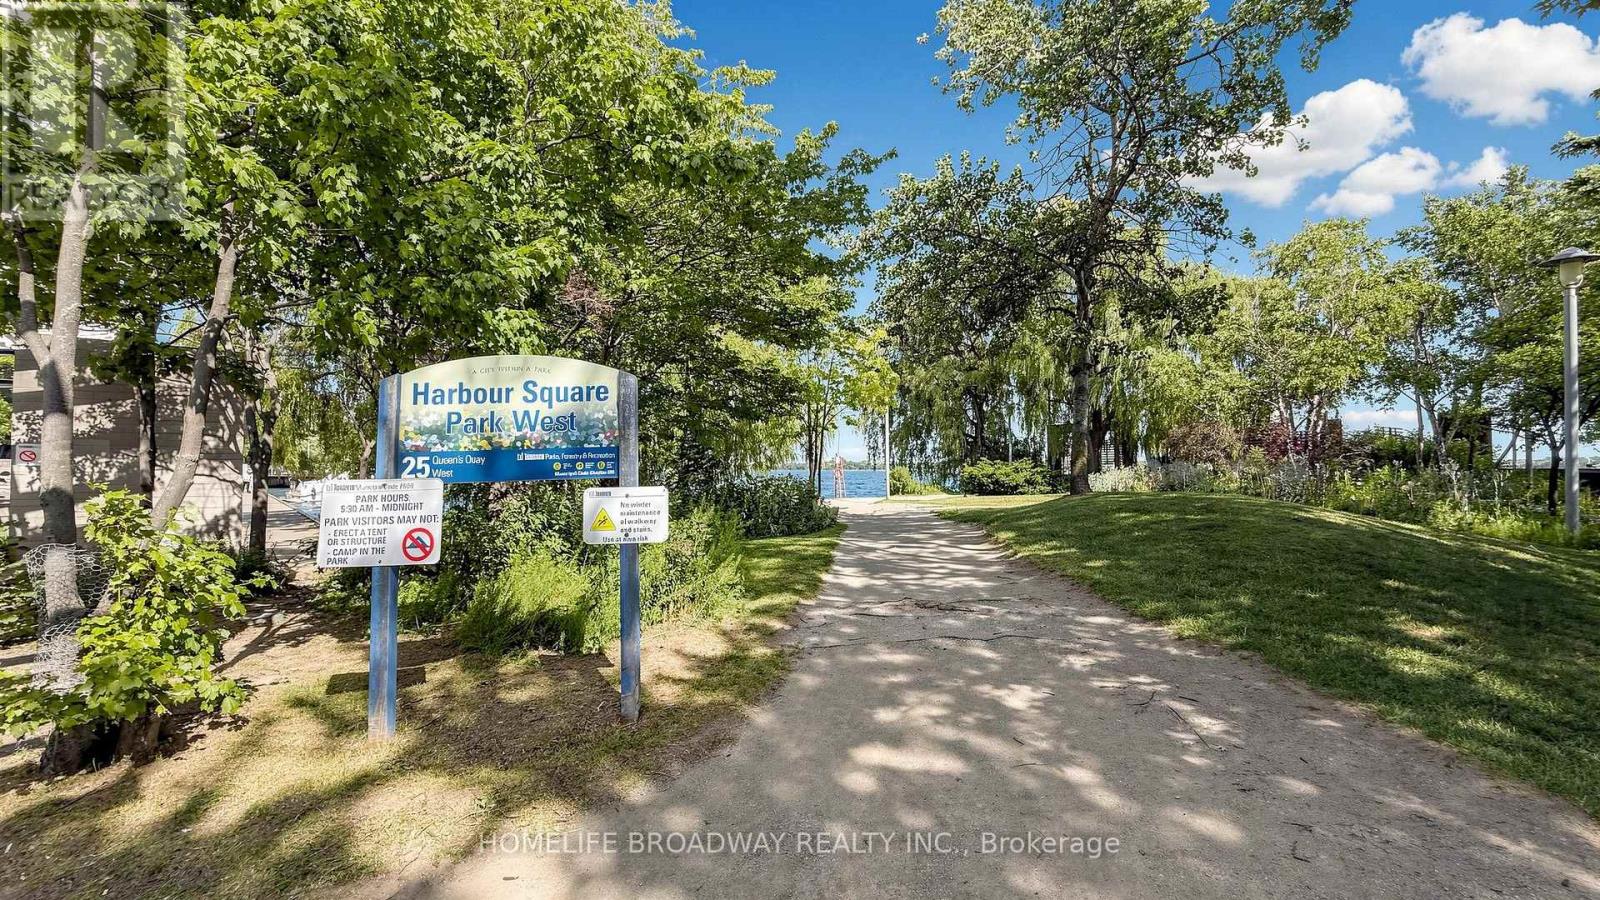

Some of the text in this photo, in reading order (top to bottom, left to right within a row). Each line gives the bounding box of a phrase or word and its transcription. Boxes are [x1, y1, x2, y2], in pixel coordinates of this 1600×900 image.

[412, 380, 610, 409] Harbour Square
[446, 409, 577, 435] Park West
[401, 454, 486, 479] 25 Queen's Quay
[431, 468, 454, 478] West
[355, 494, 379, 503] PARK
[359, 504, 374, 513] AM
[381, 502, 424, 512] MIDNIGHT
[324, 514, 439, 527] PARK VISITORS MAY NOT:
[333, 529, 358, 537] ERECT
[368, 528, 388, 536] TENT
[327, 536, 387, 546] OR STRUCTURE
[332, 548, 358, 556] CAMP
[370, 547, 386, 555] THE
[326, 557, 349, 565] PARK
